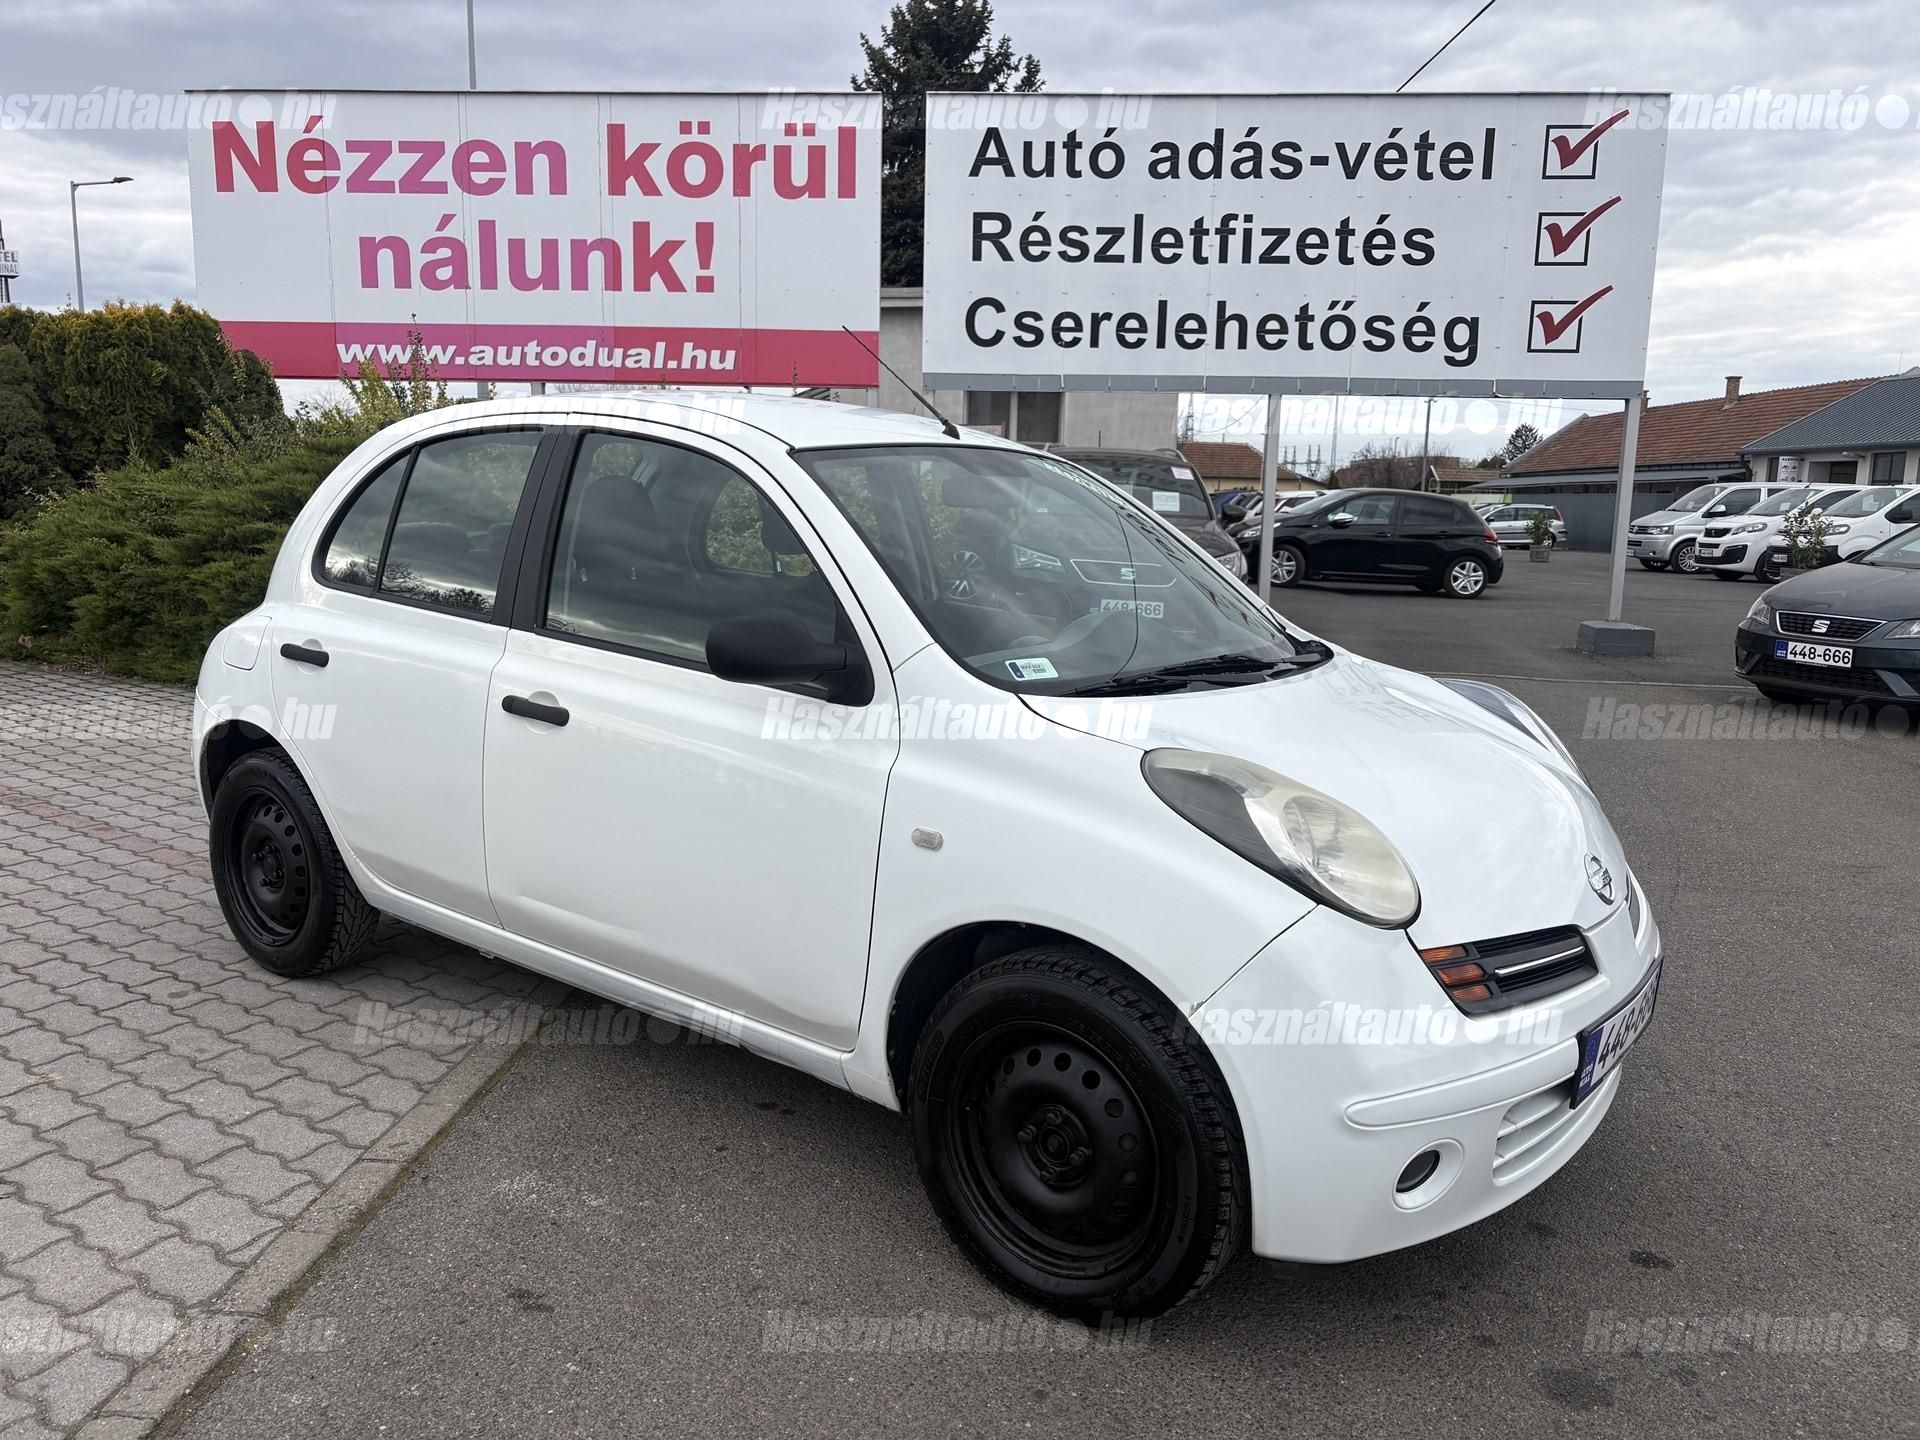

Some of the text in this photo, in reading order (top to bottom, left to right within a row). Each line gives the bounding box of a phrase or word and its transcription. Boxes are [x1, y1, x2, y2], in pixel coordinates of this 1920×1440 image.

[212, 115, 858, 200] Nézzen körül
[968, 126, 1496, 181] Autó adás-vétel
[358, 213, 716, 293] nálunk!
[971, 210, 1437, 266] Részletfizetés
[336, 339, 738, 371] www.autodual.hu
[965, 296, 1480, 367] Cserelehetőség
[1789, 644, 1851, 665] 448-666
